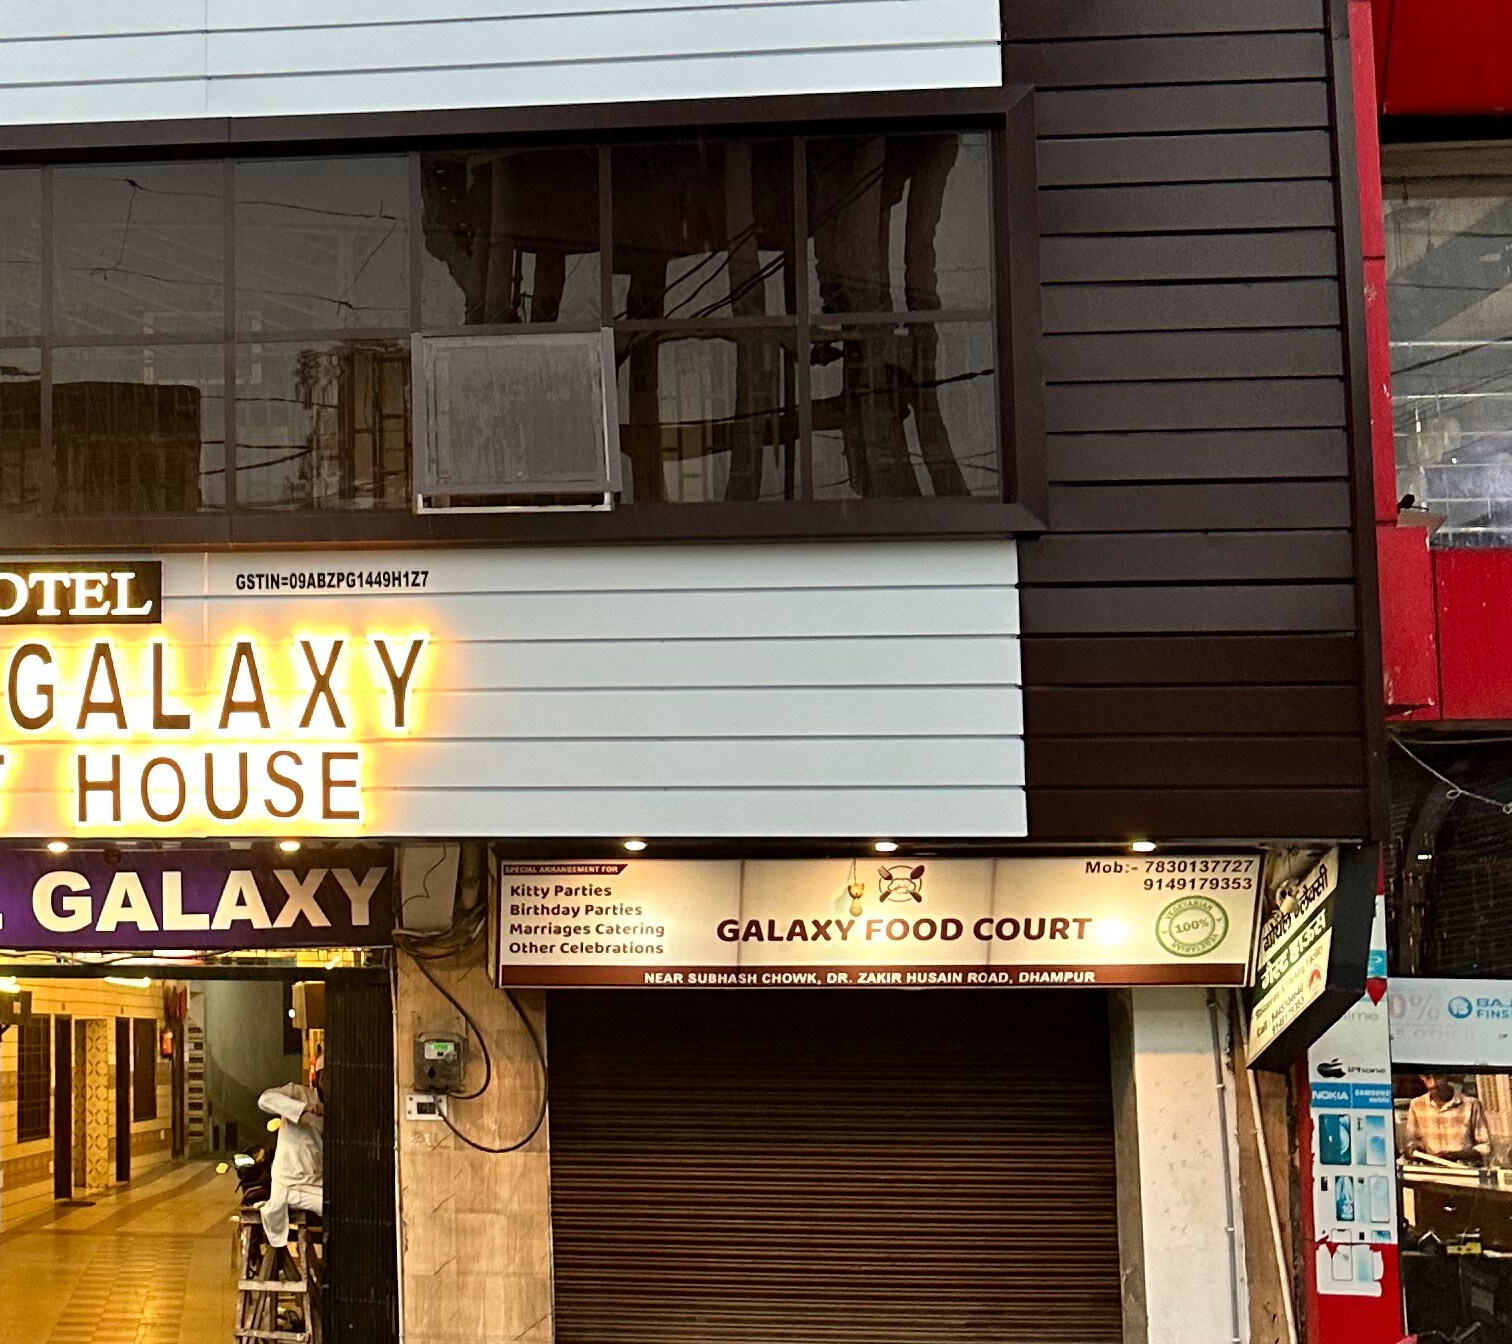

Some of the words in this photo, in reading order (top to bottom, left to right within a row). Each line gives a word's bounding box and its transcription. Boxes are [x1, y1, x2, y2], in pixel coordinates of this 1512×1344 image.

[236, 570, 429, 590] GSTIN=09ABZPG1449H1Z7
[8, 639, 424, 729] GALAXY
[78, 750, 359, 822] HOUSE
[504, 866, 538, 874] SPECIAL
[539, 865, 600, 873] ARRANGEMENT
[601, 865, 619, 873] FOR
[1144, 860, 1254, 874] 7830137727
[510, 884, 550, 899] Kitty
[554, 884, 612, 897] Parties
[1143, 878, 1253, 891] 9149179353
[31, 867, 386, 933] GALAXY
[510, 903, 581, 918] Birthday
[585, 903, 643, 916] Parties
[509, 922, 591, 937] Marriages
[595, 922, 665, 937] Catering
[717, 918, 856, 942] GALAXY
[865, 917, 963, 942] FOOD
[973, 916, 1093, 941] COURT
[1174, 918, 1210, 934] 100%
[509, 941, 556, 954] Other
[560, 941, 664, 954] Celebrations
[643, 972, 684, 984] NEAR
[687, 972, 758, 984] SUBHASH
[761, 972, 822, 985] CHOWK,
[826, 972, 854, 984] DR.
[857, 972, 903, 984] ZAKIR
[906, 972, 963, 984] HUSAIN
[966, 971, 1014, 985] ROAD,
[1018, 971, 1096, 984] DHAMPUR
[1476, 1009, 1512, 1019] FINS
[1347, 1066, 1386, 1074] iPhone
[1312, 1090, 1349, 1101] NOKIA
